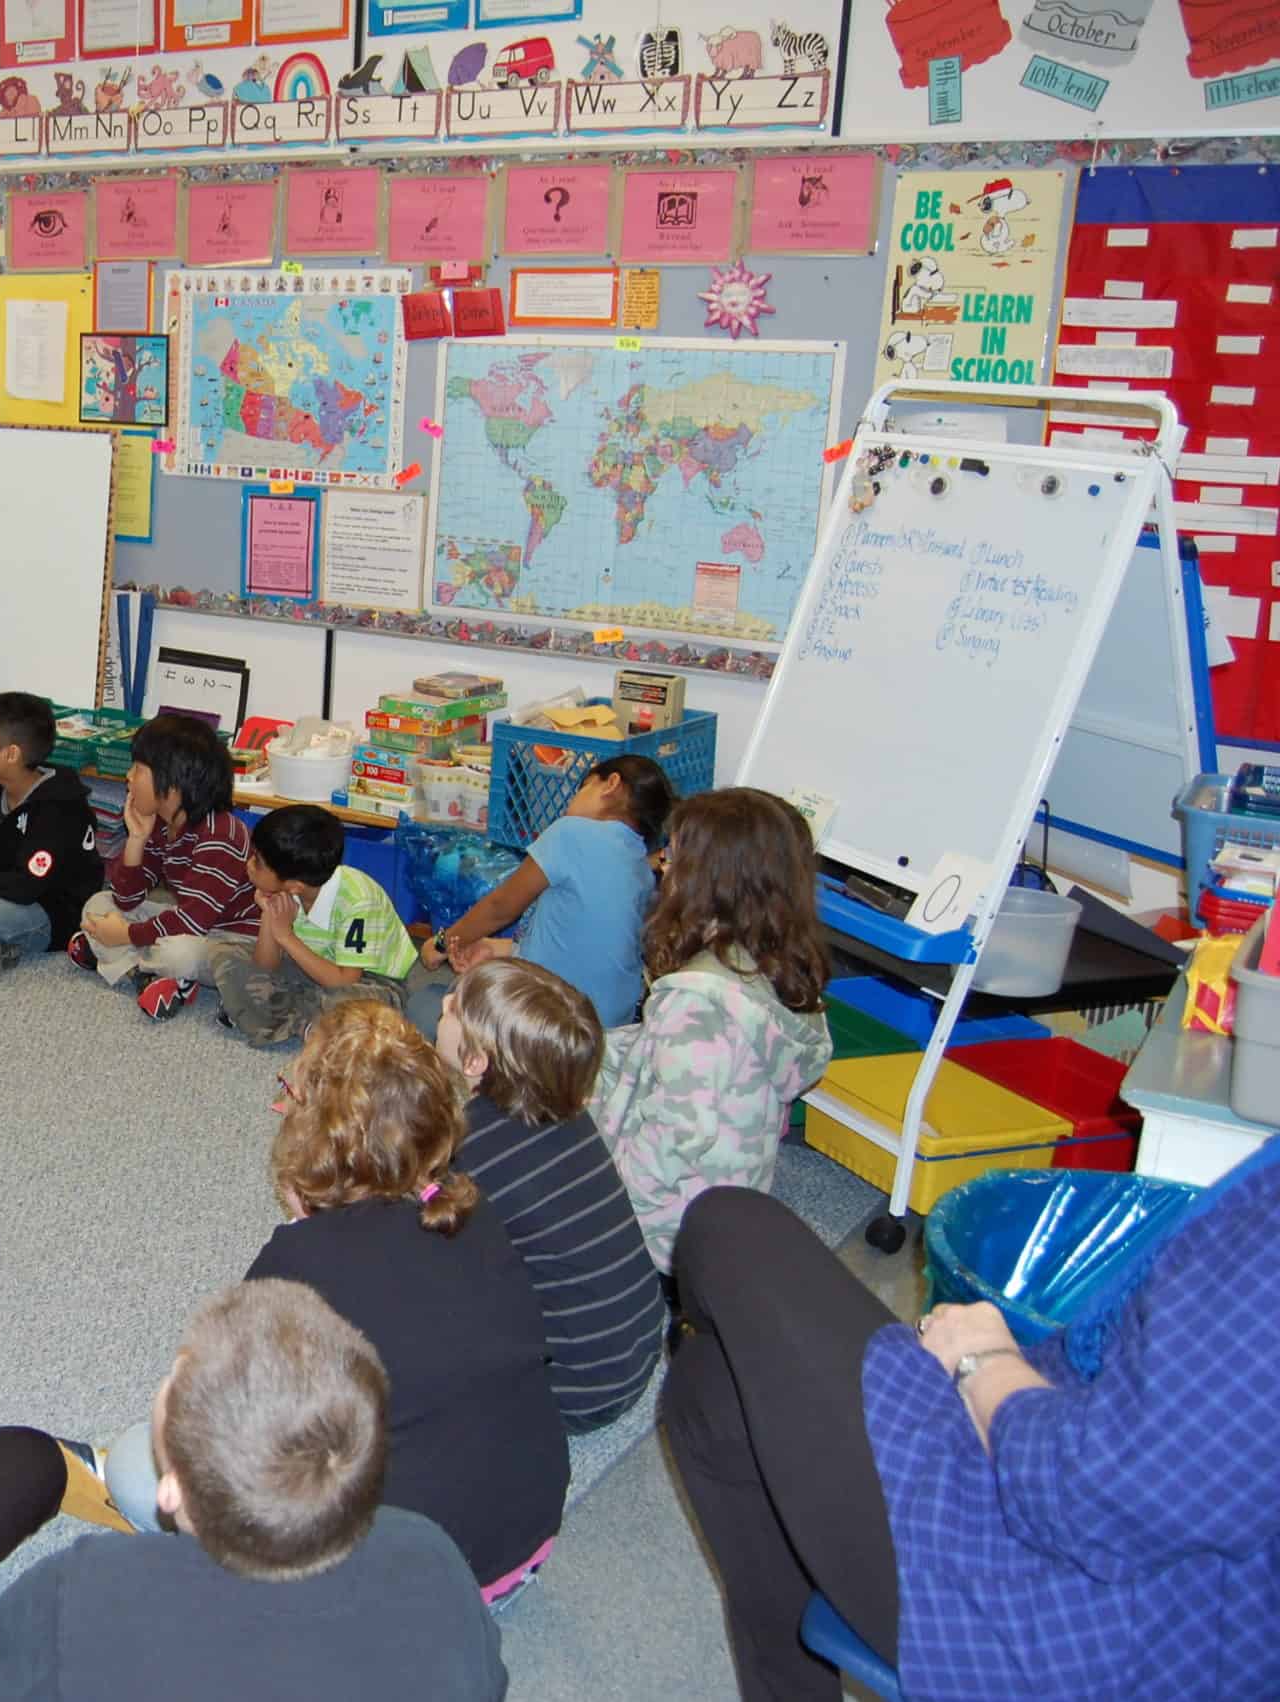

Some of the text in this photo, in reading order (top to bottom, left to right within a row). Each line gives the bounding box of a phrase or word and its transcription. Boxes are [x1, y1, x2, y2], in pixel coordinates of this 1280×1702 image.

[1047, 14, 1117, 47] October
[914, 190, 943, 221] BE
[900, 223, 956, 252] COOL
[961, 293, 1034, 325] LEARN
[980, 327, 1007, 357] IN
[950, 357, 1035, 386] SCHOOL
[344, 917, 367, 954] 4
